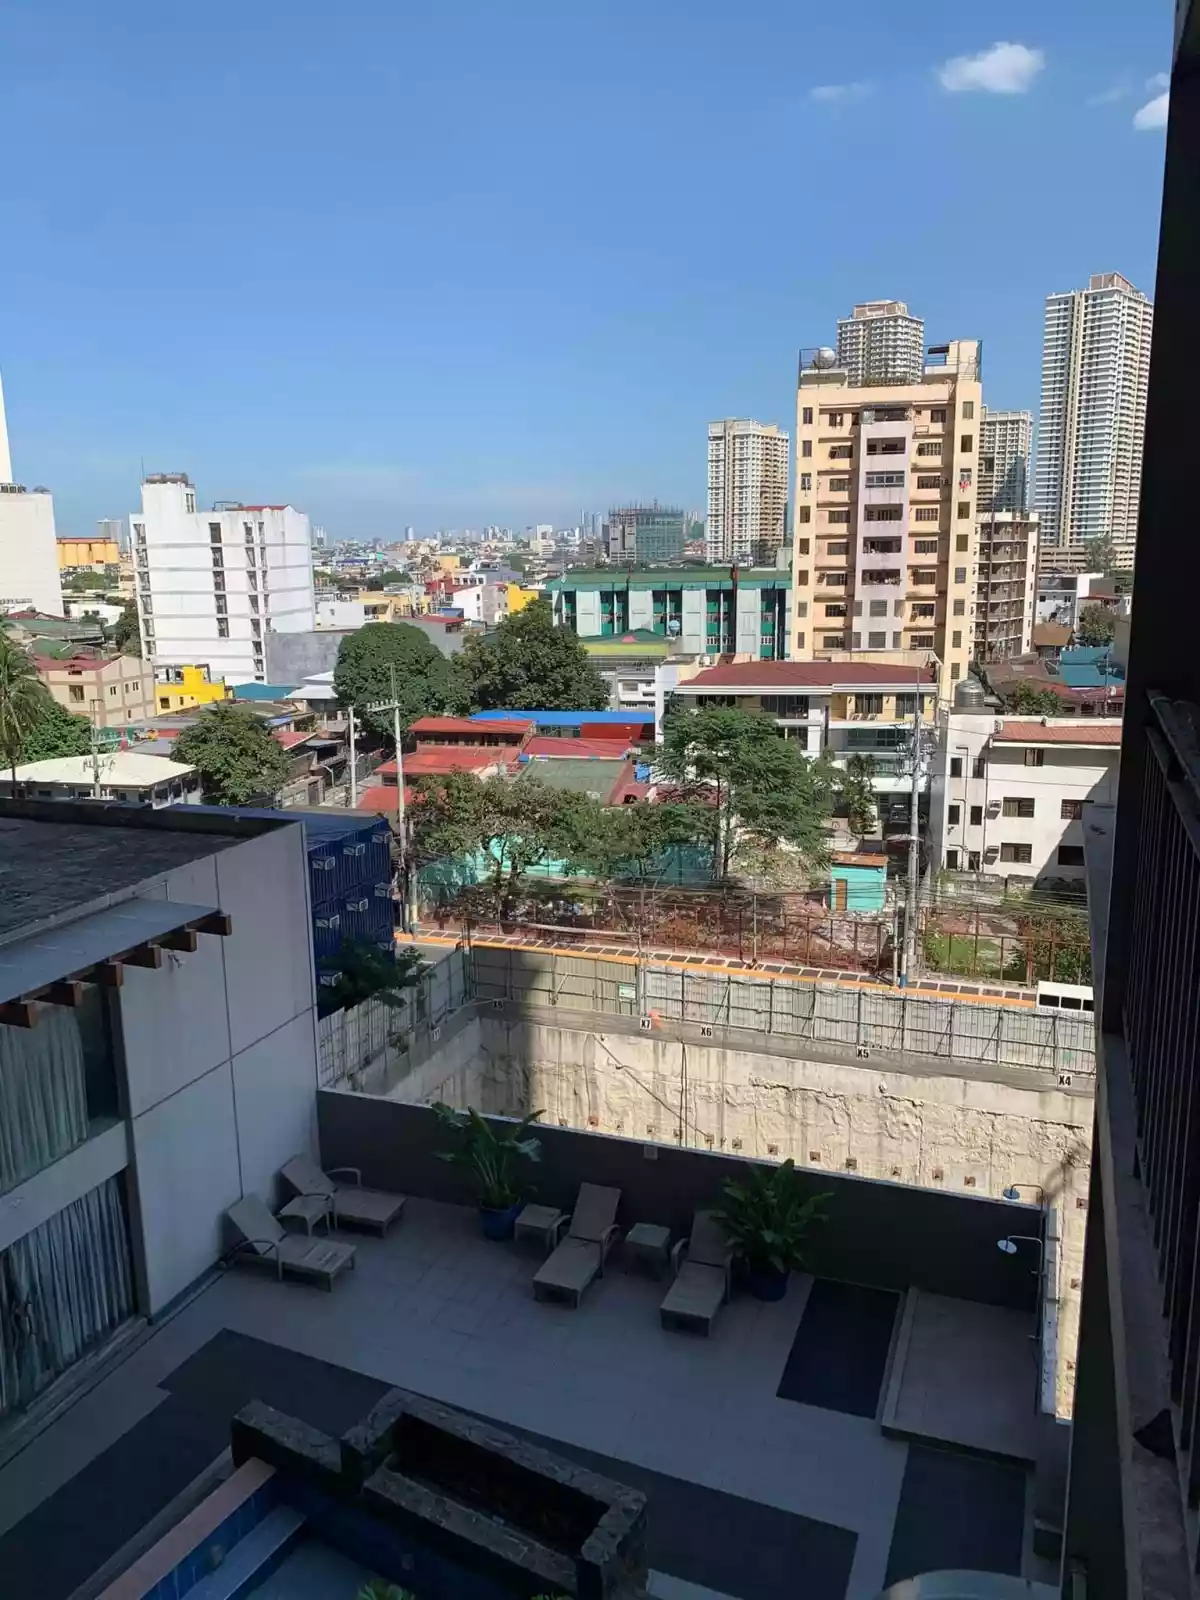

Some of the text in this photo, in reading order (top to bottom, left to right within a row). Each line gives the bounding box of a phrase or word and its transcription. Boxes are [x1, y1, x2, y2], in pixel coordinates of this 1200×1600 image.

[641, 1018, 651, 1029] X7
[700, 1026, 712, 1037] X6
[857, 1048, 869, 1059] X5
[1059, 1074, 1071, 1086] X4
